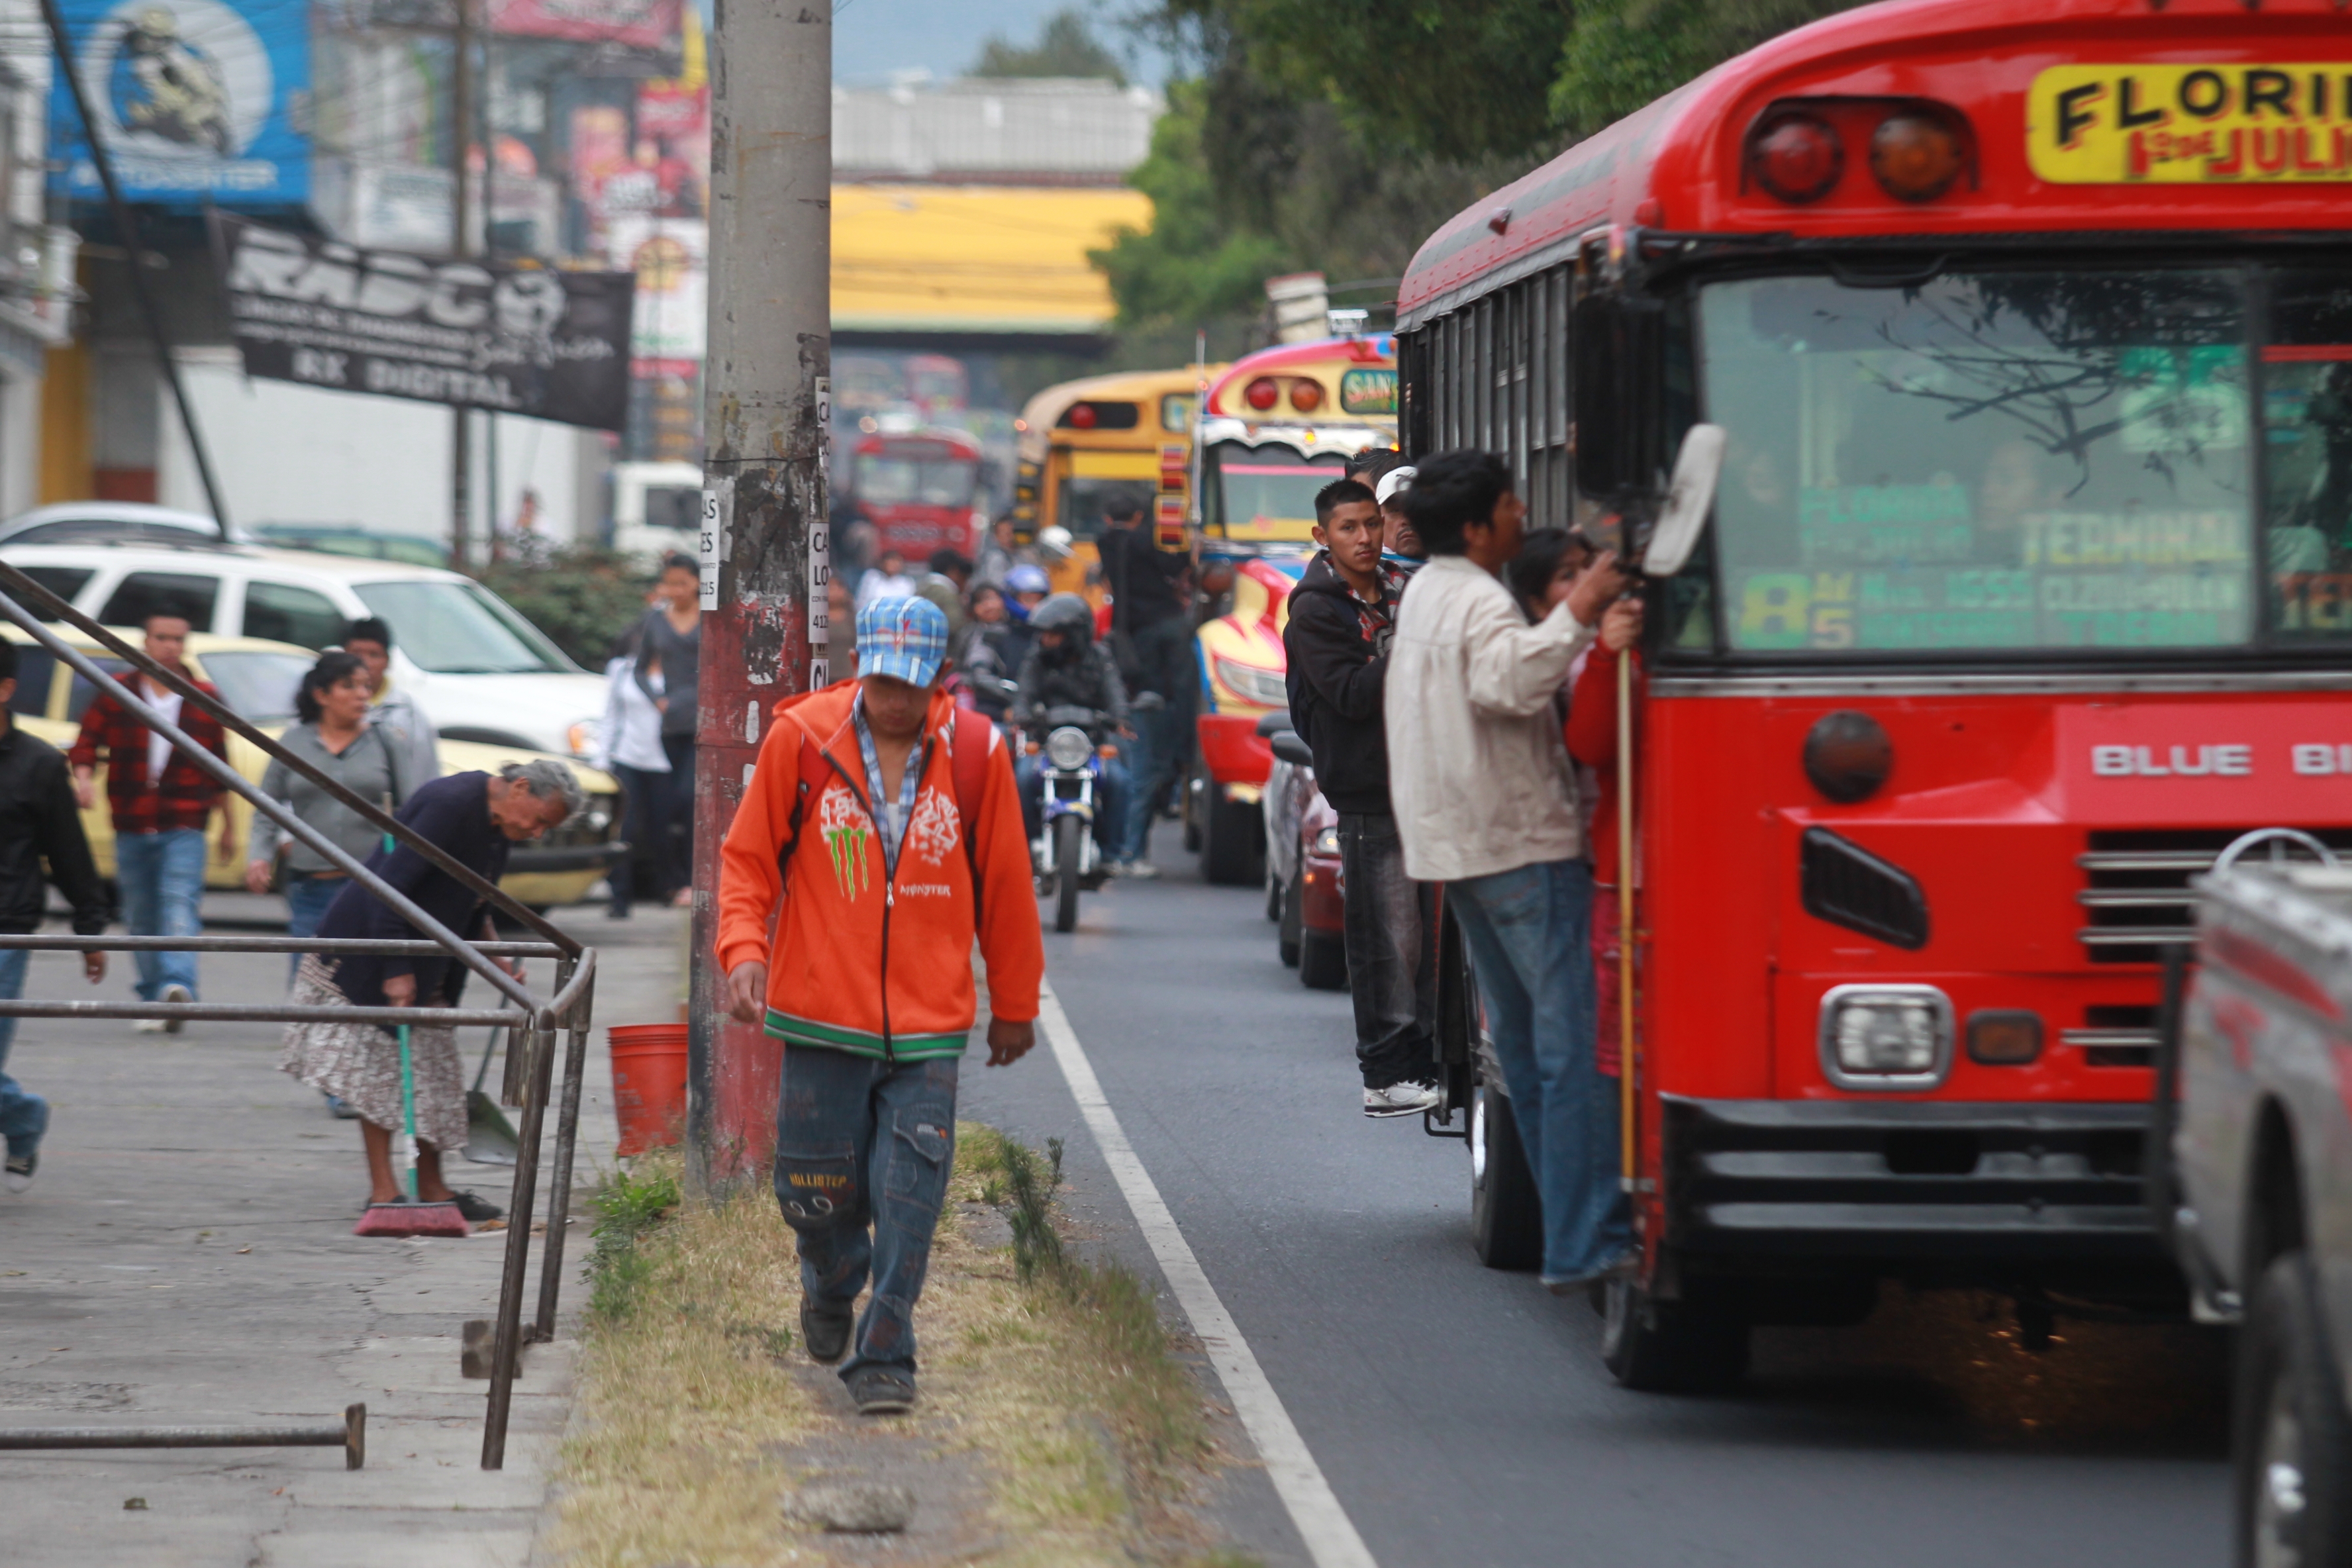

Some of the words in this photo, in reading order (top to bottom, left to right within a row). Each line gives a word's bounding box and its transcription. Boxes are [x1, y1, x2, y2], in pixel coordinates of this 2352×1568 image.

[2055, 70, 2352, 150] FLORI
[364, 359, 522, 407] DIGITAL
[1740, 573, 1812, 649] 8
[1812, 607, 1853, 650] 5
[2090, 744, 2253, 775] BLUE
